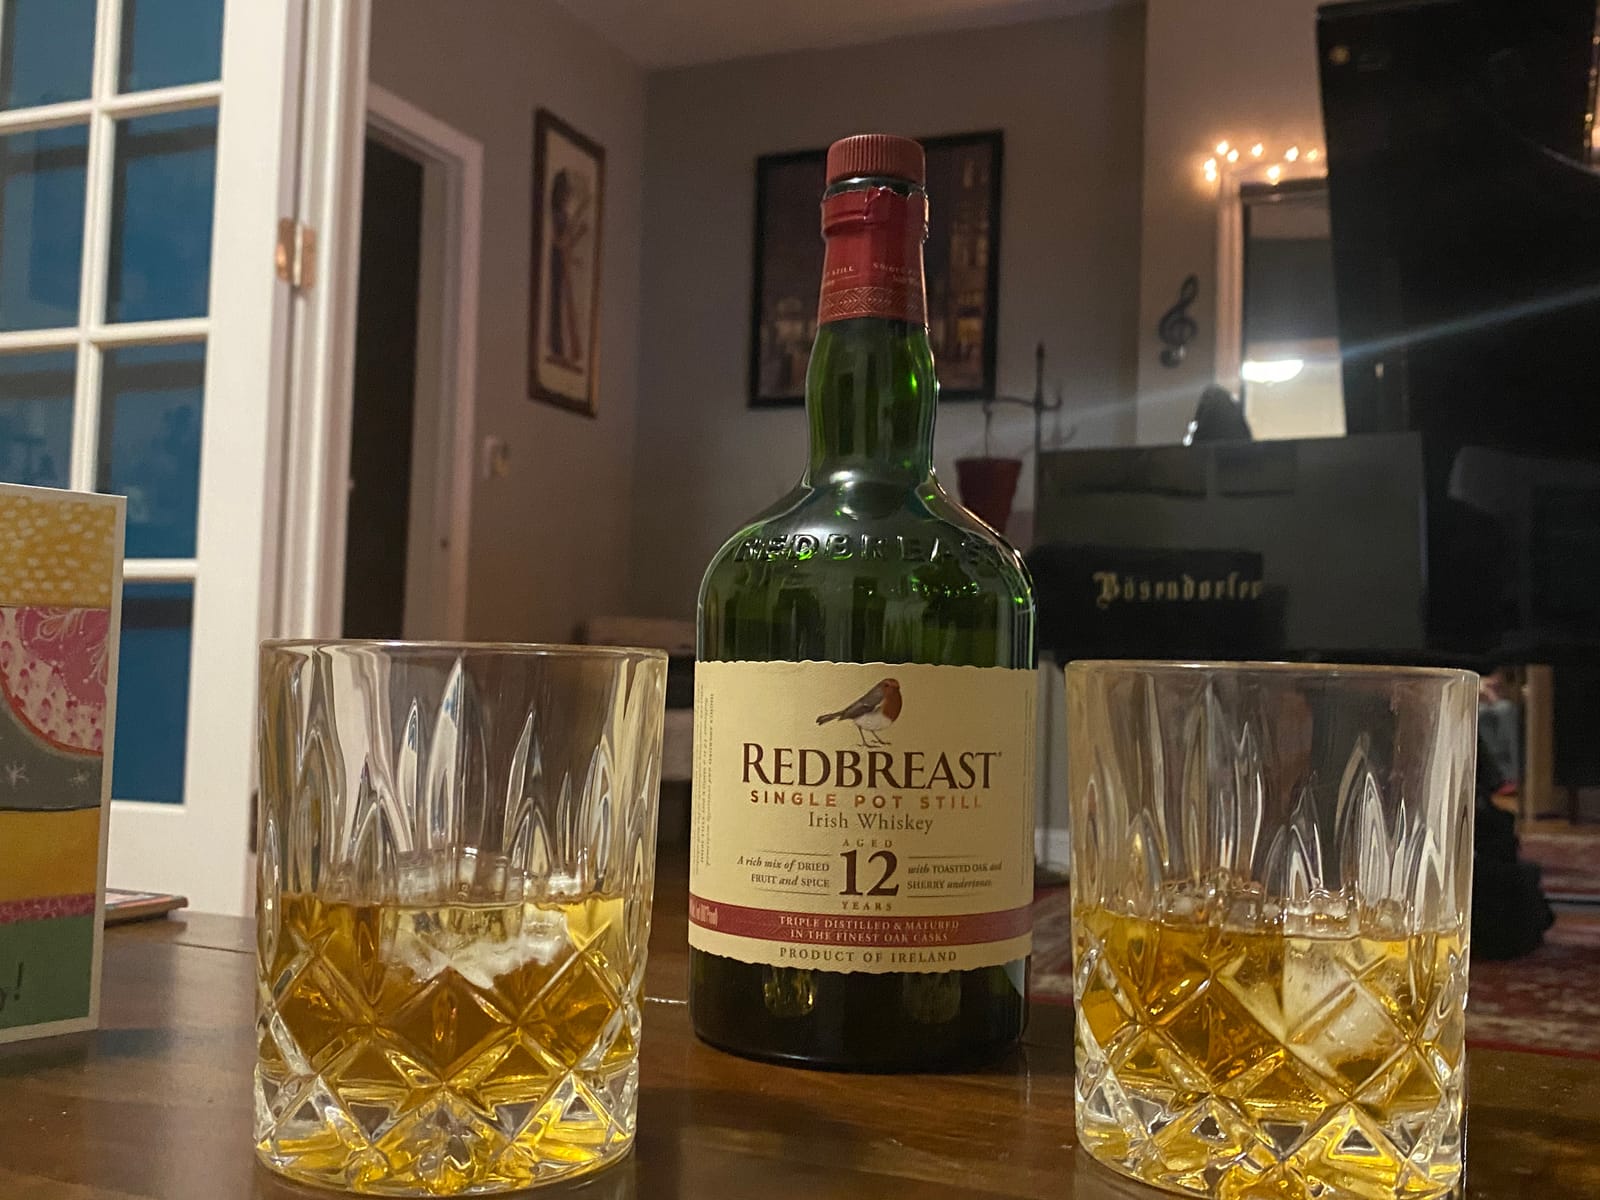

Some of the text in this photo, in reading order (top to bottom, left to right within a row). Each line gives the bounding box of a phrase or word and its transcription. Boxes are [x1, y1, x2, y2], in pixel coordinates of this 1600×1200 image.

[742, 742, 998, 790] REDBREAST
[750, 789, 984, 810] SINGLE POT STILL
[808, 811, 934, 835] Irish Whiskey
[841, 838, 894, 849] AGED
[737, 855, 830, 873] A rich mix of DRIED
[839, 848, 900, 897] 12
[907, 863, 930, 875] with
[932, 863, 971, 875] TOASTED
[971, 863, 988, 873] OAK
[751, 873, 830, 889] FRUIT and SPICE
[842, 900, 893, 912] YEARS
[779, 915, 961, 931] TRIPLE DISTILLED & MATURED
[790, 928, 949, 944] IN THE FINEST OAK CASKS
[779, 946, 958, 964] PRODUCT OF IRELAND
